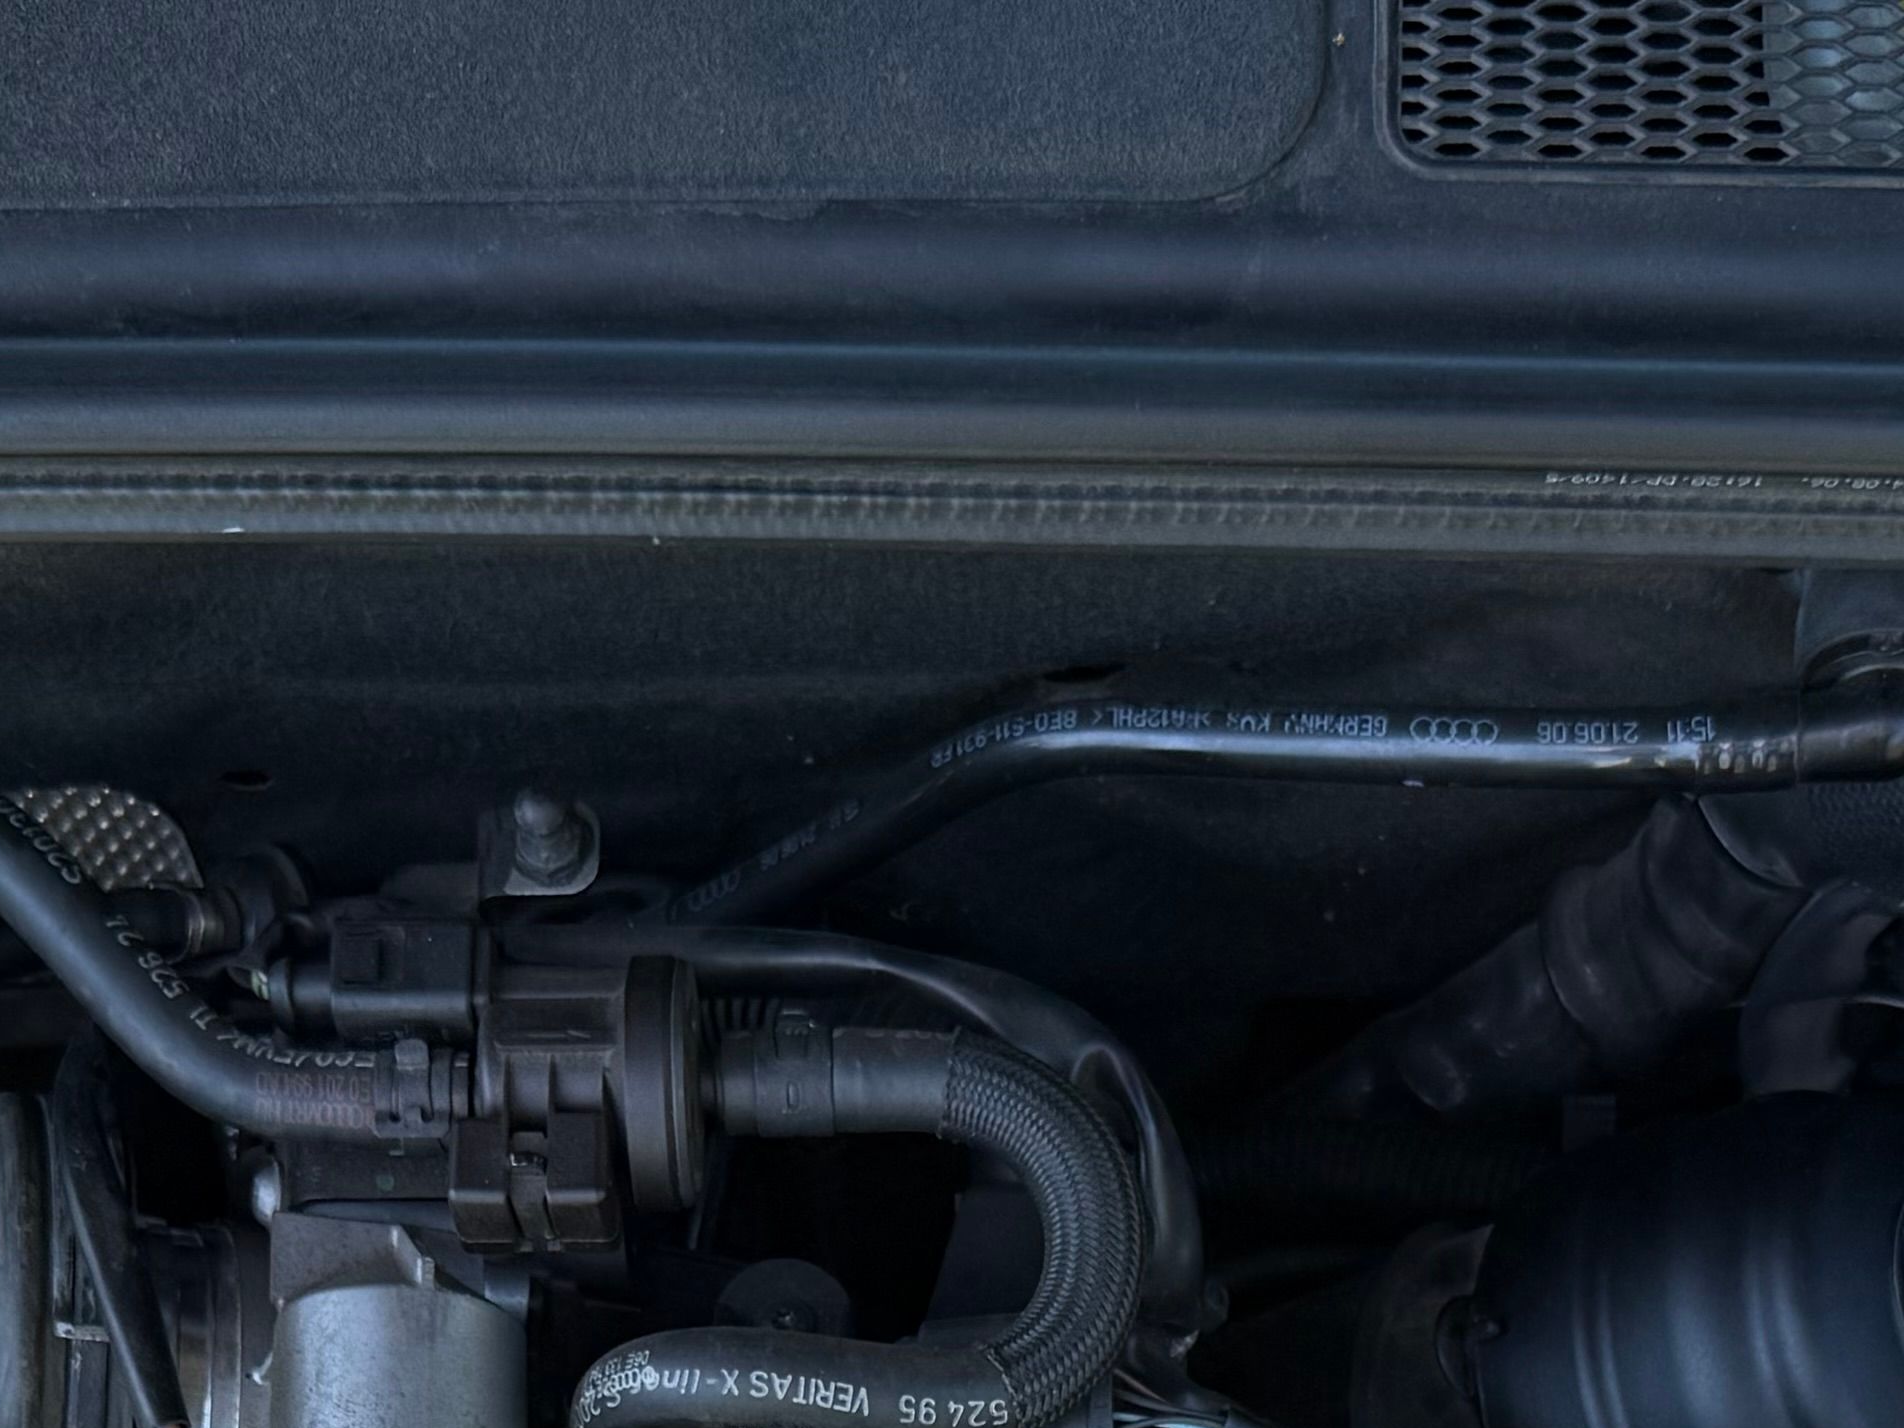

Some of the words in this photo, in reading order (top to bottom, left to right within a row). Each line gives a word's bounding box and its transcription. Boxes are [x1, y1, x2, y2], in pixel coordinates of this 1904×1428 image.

[1536, 719, 1639, 744] 21.06.06
[749, 1370, 871, 1418] VERITAS
[899, 1394, 938, 1425] 95
[948, 1397, 1009, 1428] 524
